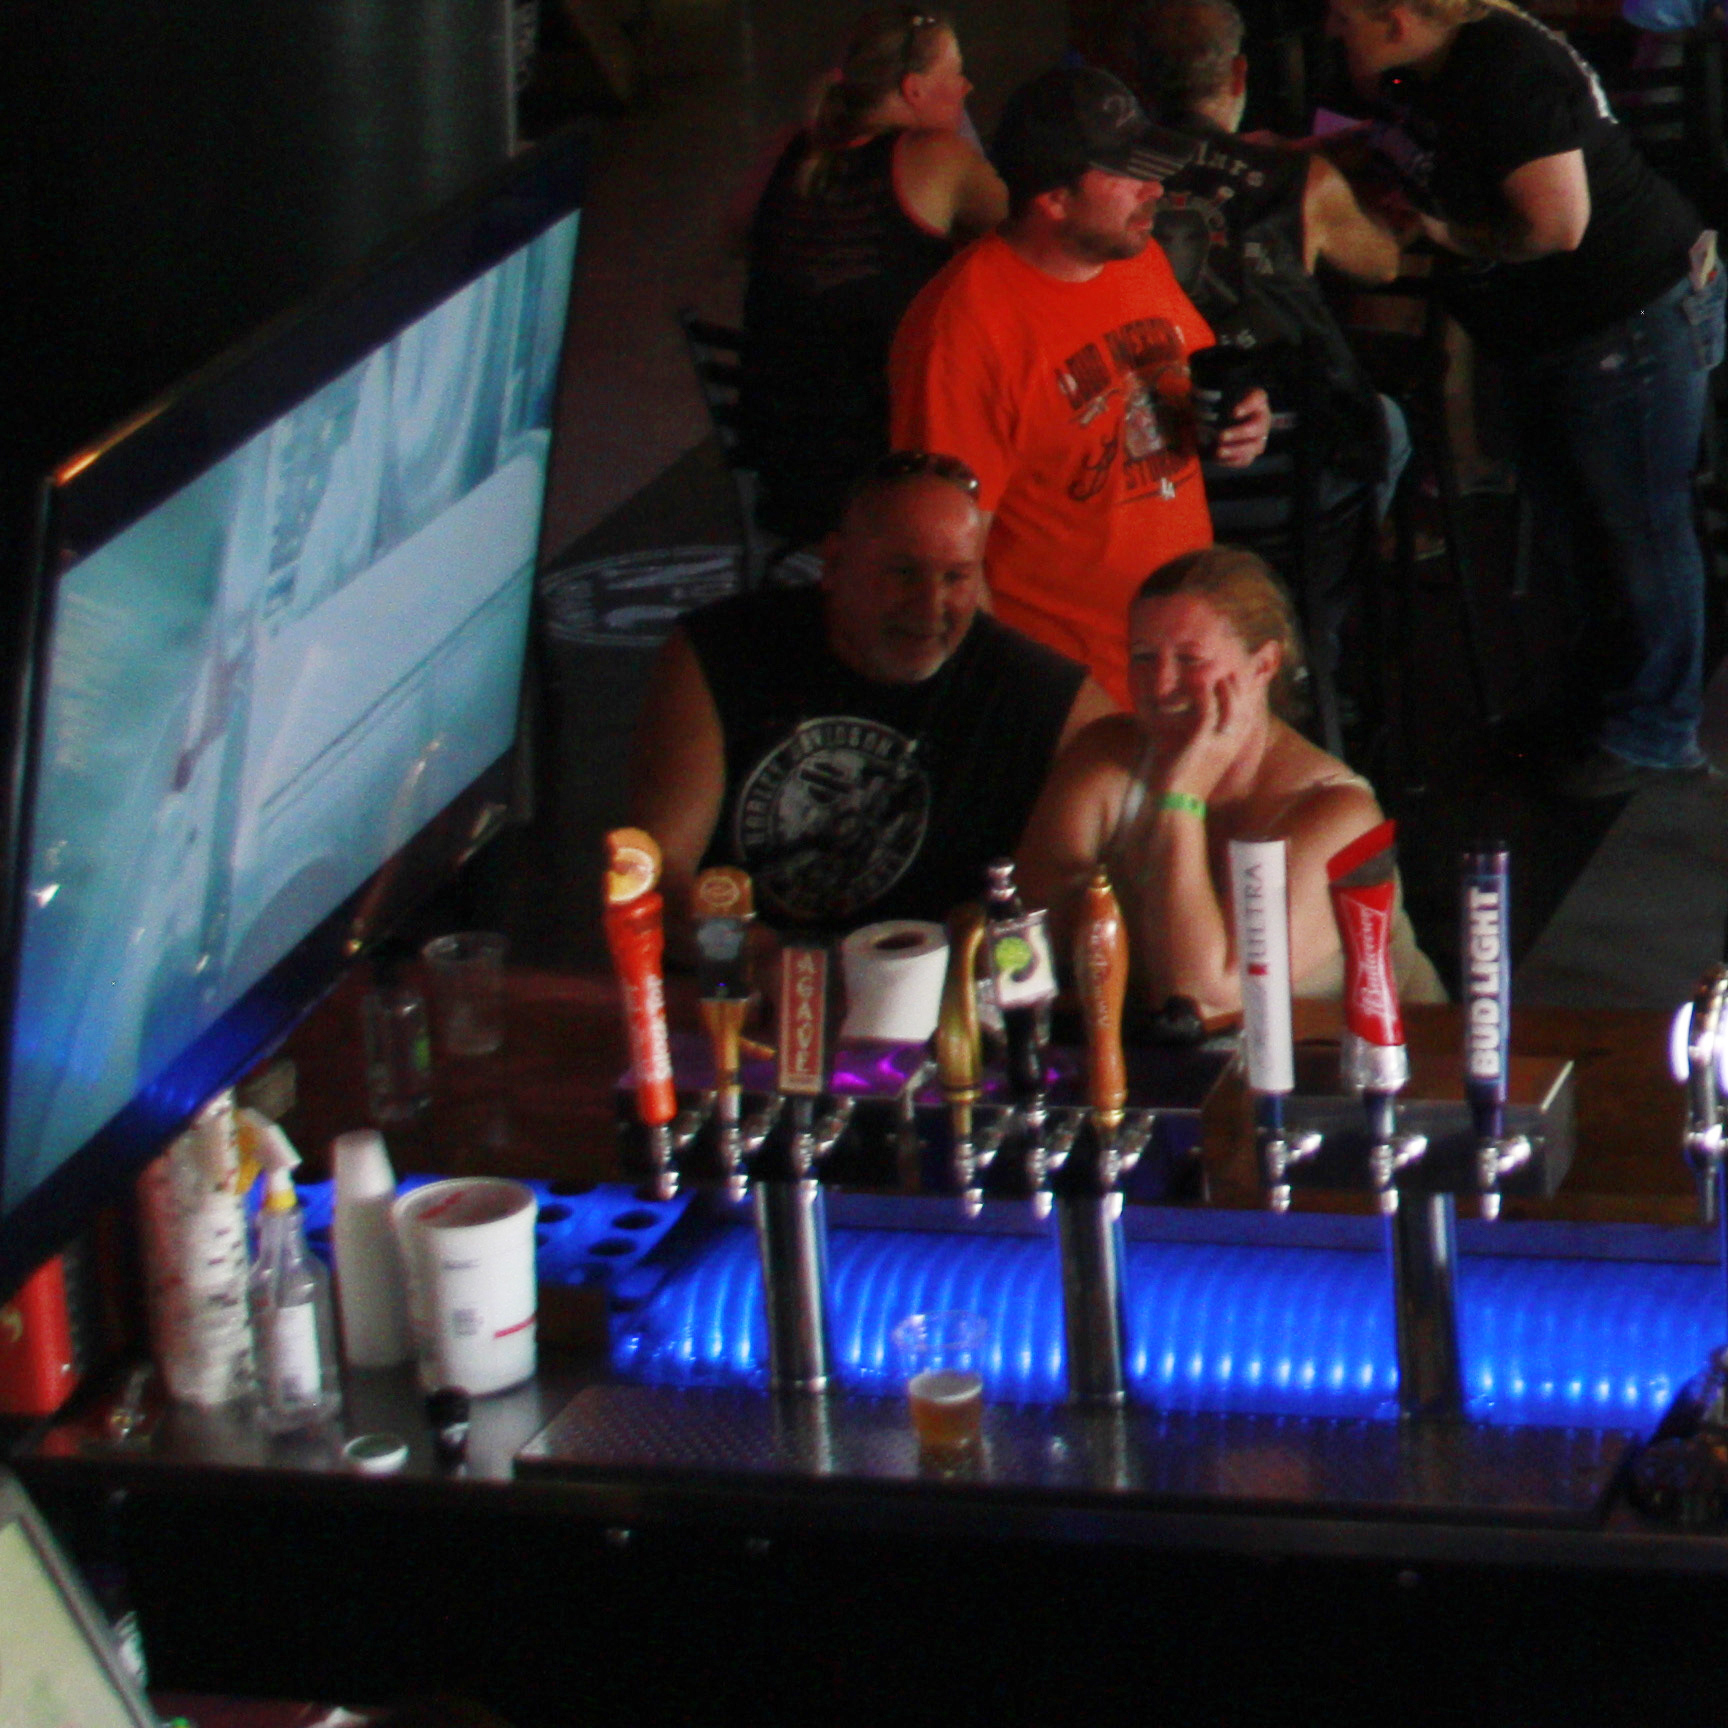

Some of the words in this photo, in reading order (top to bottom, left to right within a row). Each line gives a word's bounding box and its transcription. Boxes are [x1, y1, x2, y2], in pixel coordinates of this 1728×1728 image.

[1243, 862, 1269, 960] ULTRA
[1469, 885, 1500, 996] LIGHT
[795, 953, 816, 1074] AGAVE
[1470, 997, 1500, 1078] BUD
